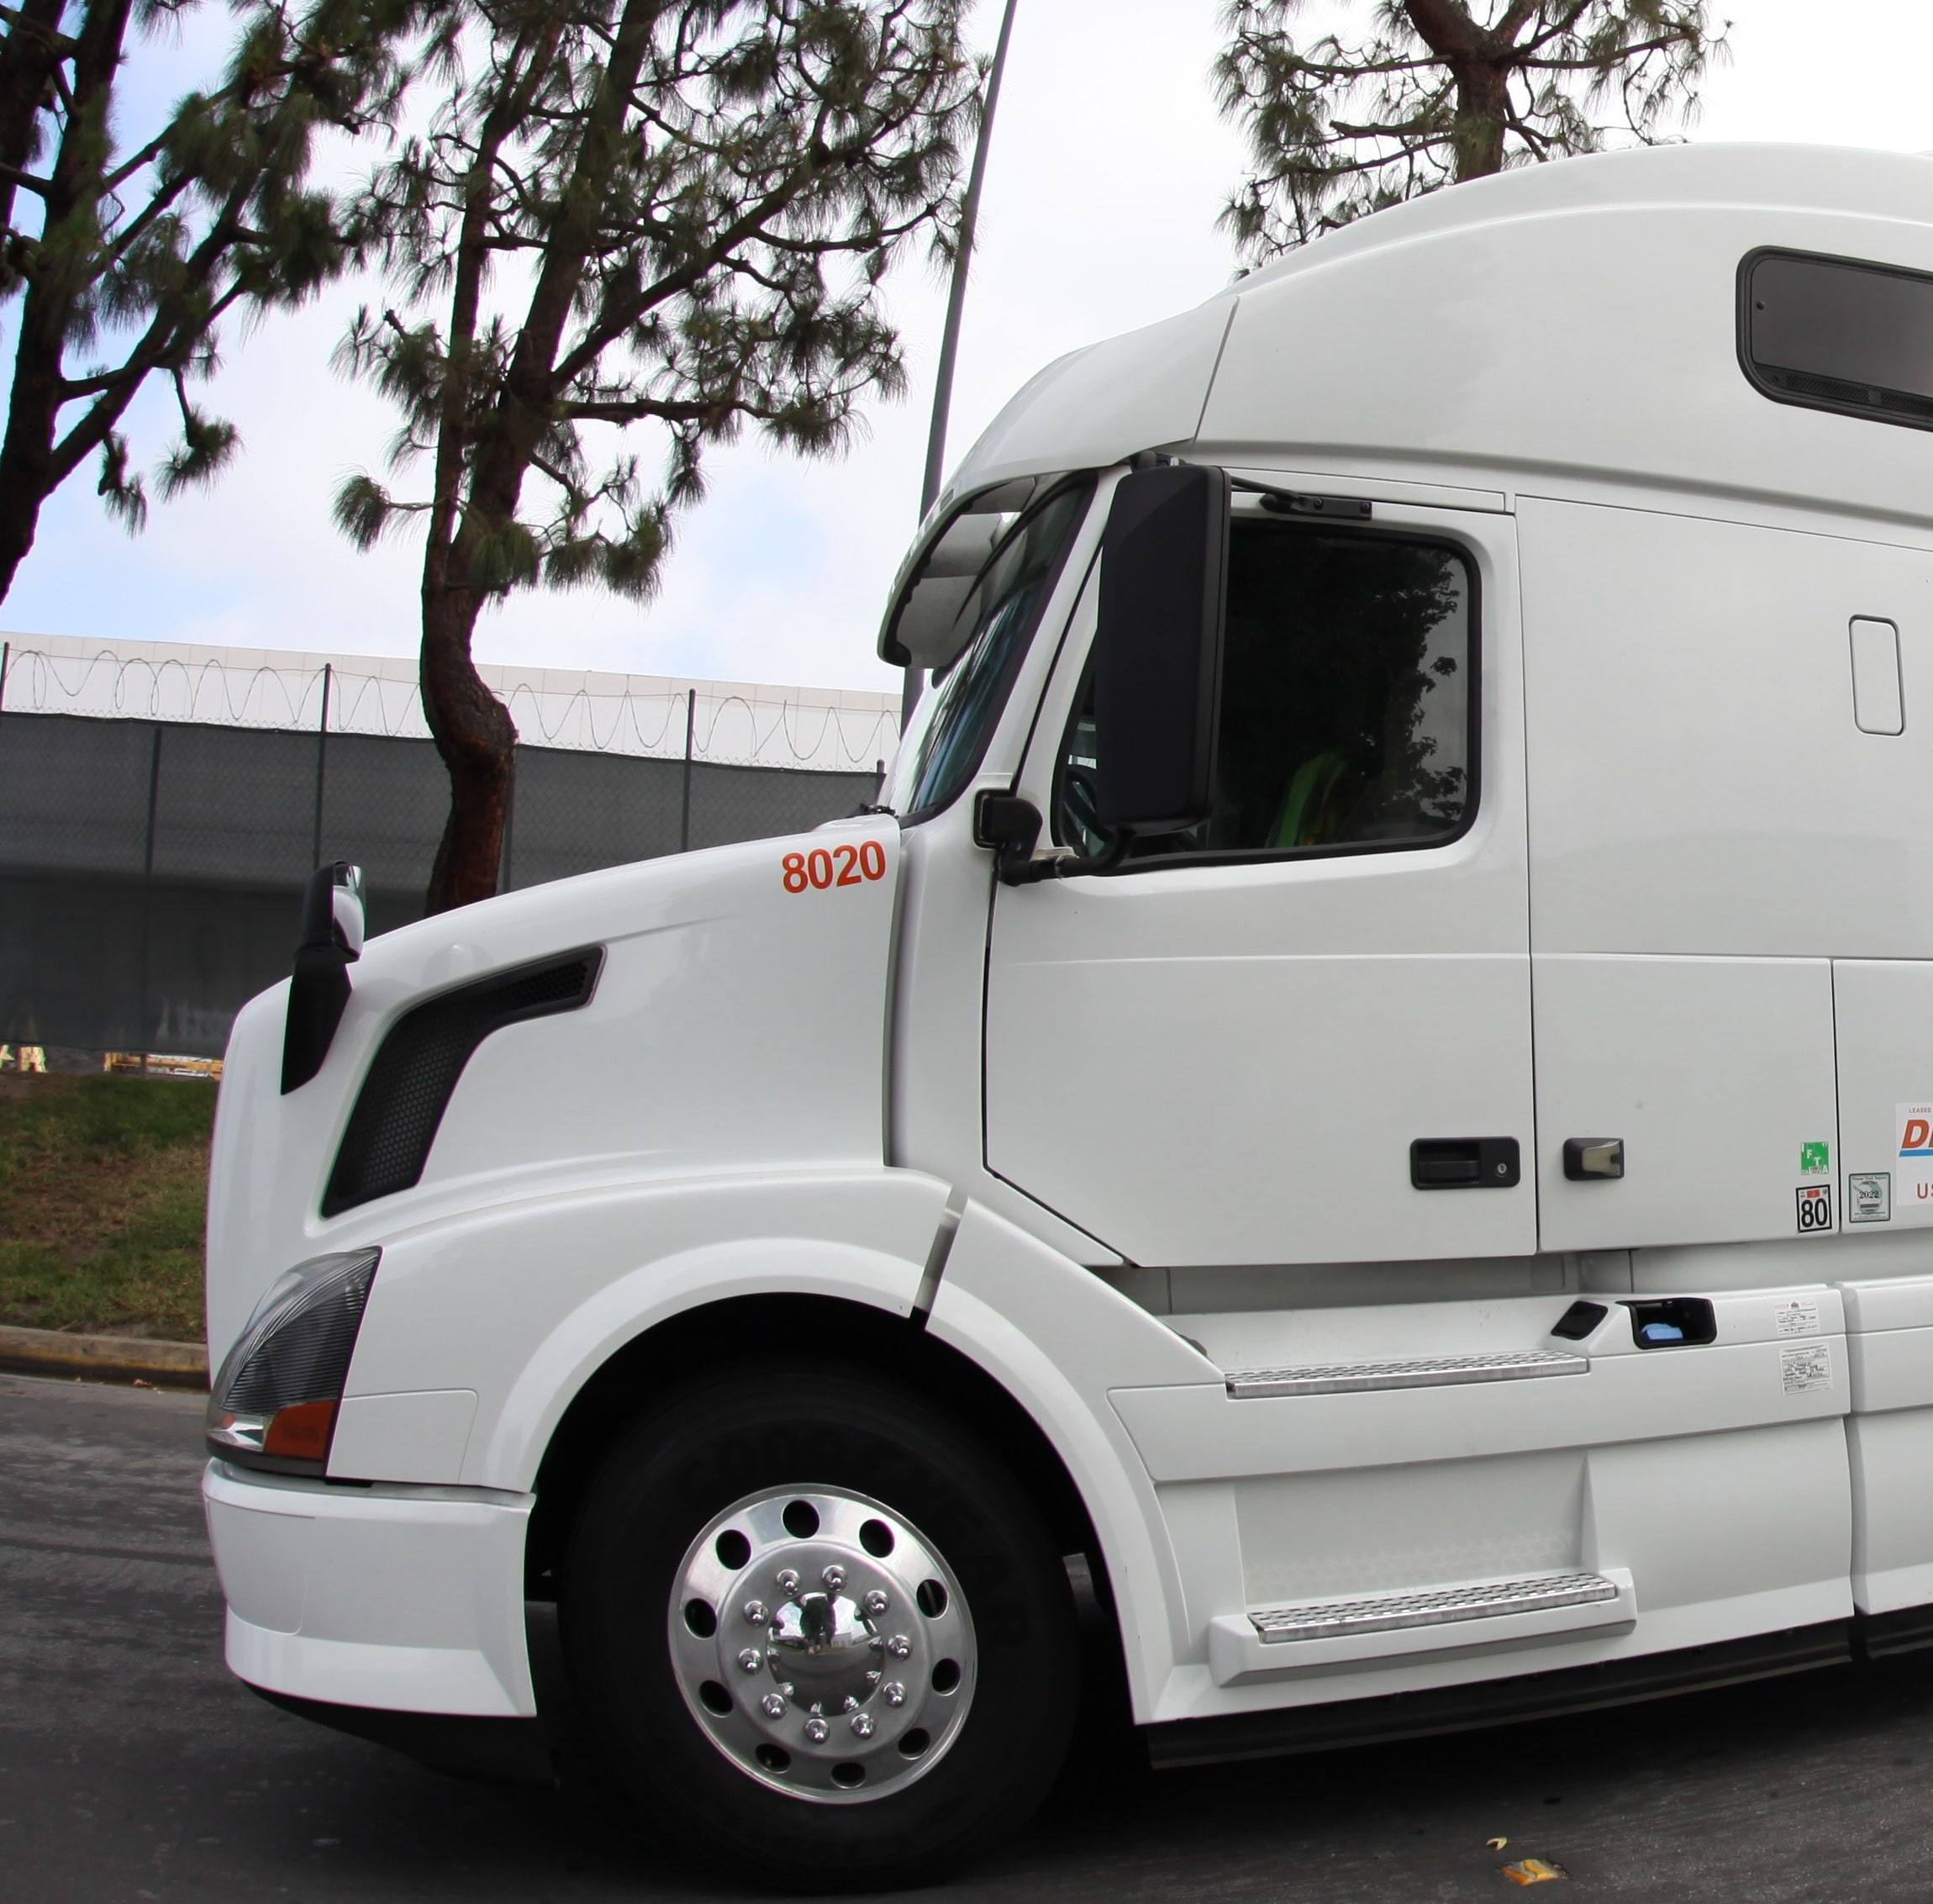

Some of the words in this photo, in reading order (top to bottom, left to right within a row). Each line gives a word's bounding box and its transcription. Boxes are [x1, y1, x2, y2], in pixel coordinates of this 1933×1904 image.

[782, 840, 886, 894] 8020
[1901, 1119, 1933, 1149] D
[1859, 1189, 1879, 1200] 2022
[1917, 1183, 1933, 1199] U
[1801, 1198, 1828, 1227] 80
